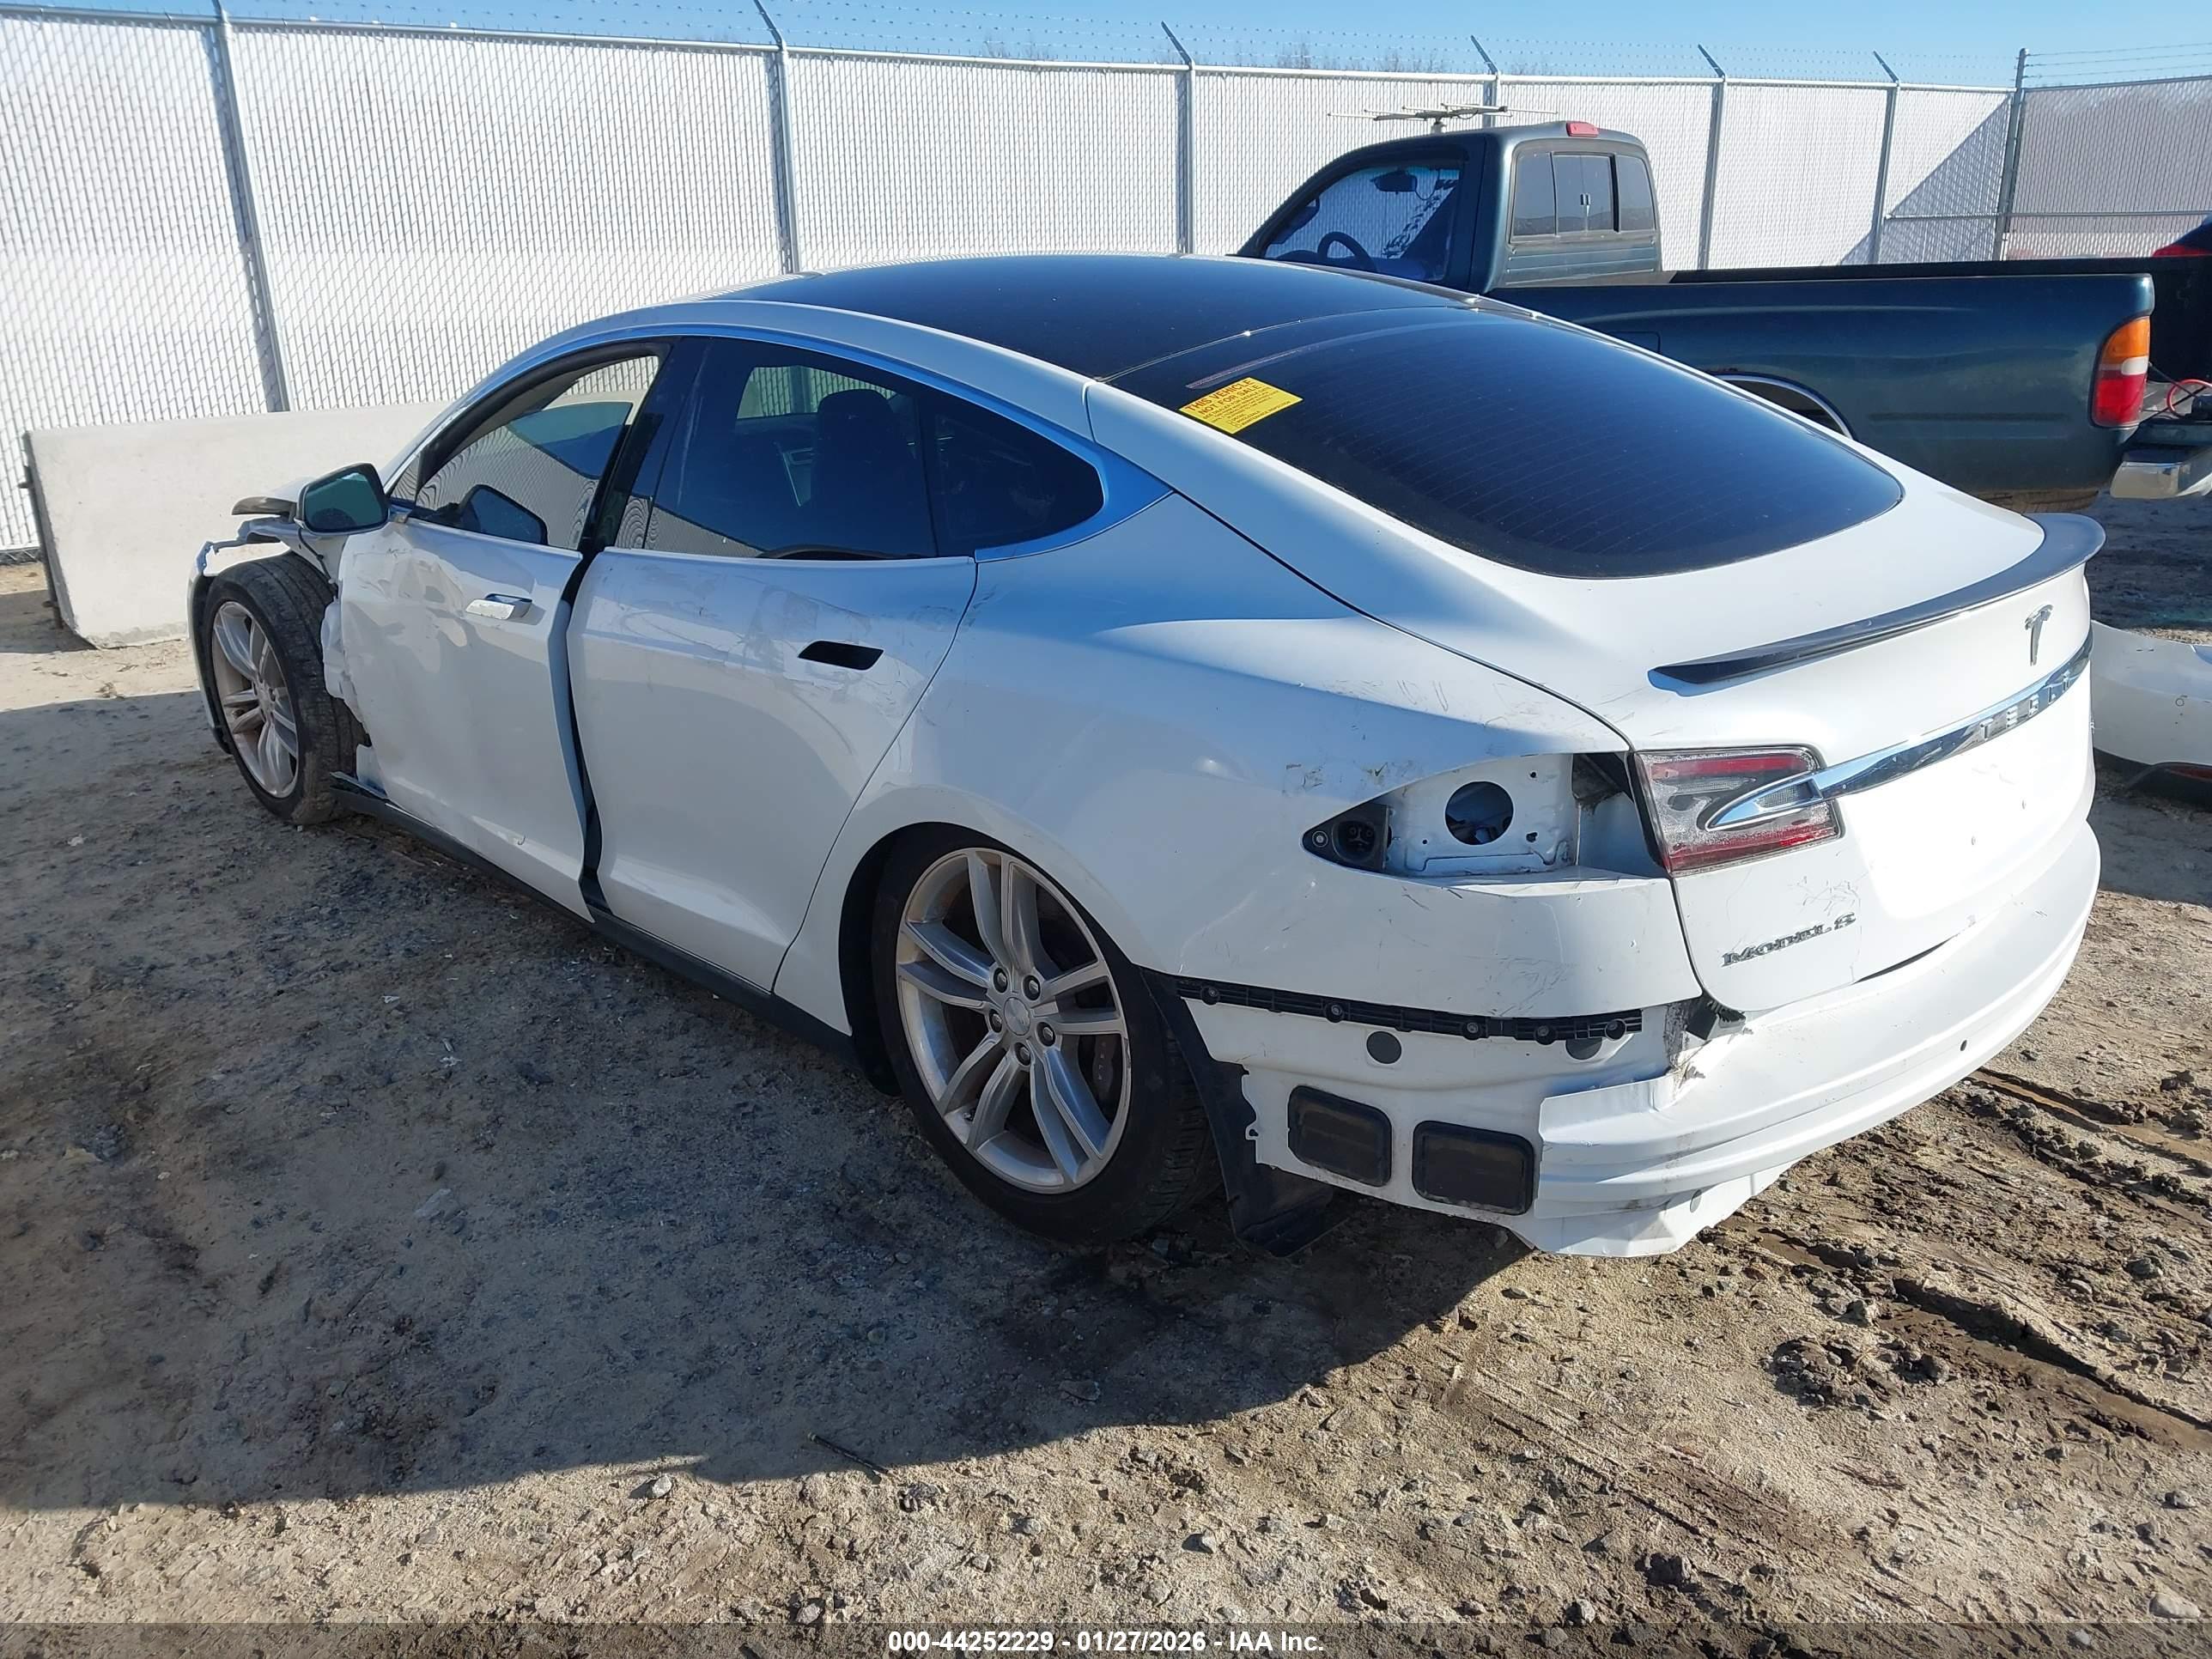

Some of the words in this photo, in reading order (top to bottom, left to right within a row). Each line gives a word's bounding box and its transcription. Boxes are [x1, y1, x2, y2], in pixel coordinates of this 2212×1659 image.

[1185, 398, 1212, 411] THIS
[1209, 380, 1254, 399] VEHICLE
[1198, 404, 1218, 415] NOT
[1218, 394, 1237, 405] FOR
[1237, 385, 1261, 396] SALE
[1979, 671, 2071, 741] TESLA
[1722, 923, 1832, 967] MODEL
[1834, 912, 1856, 930] S
